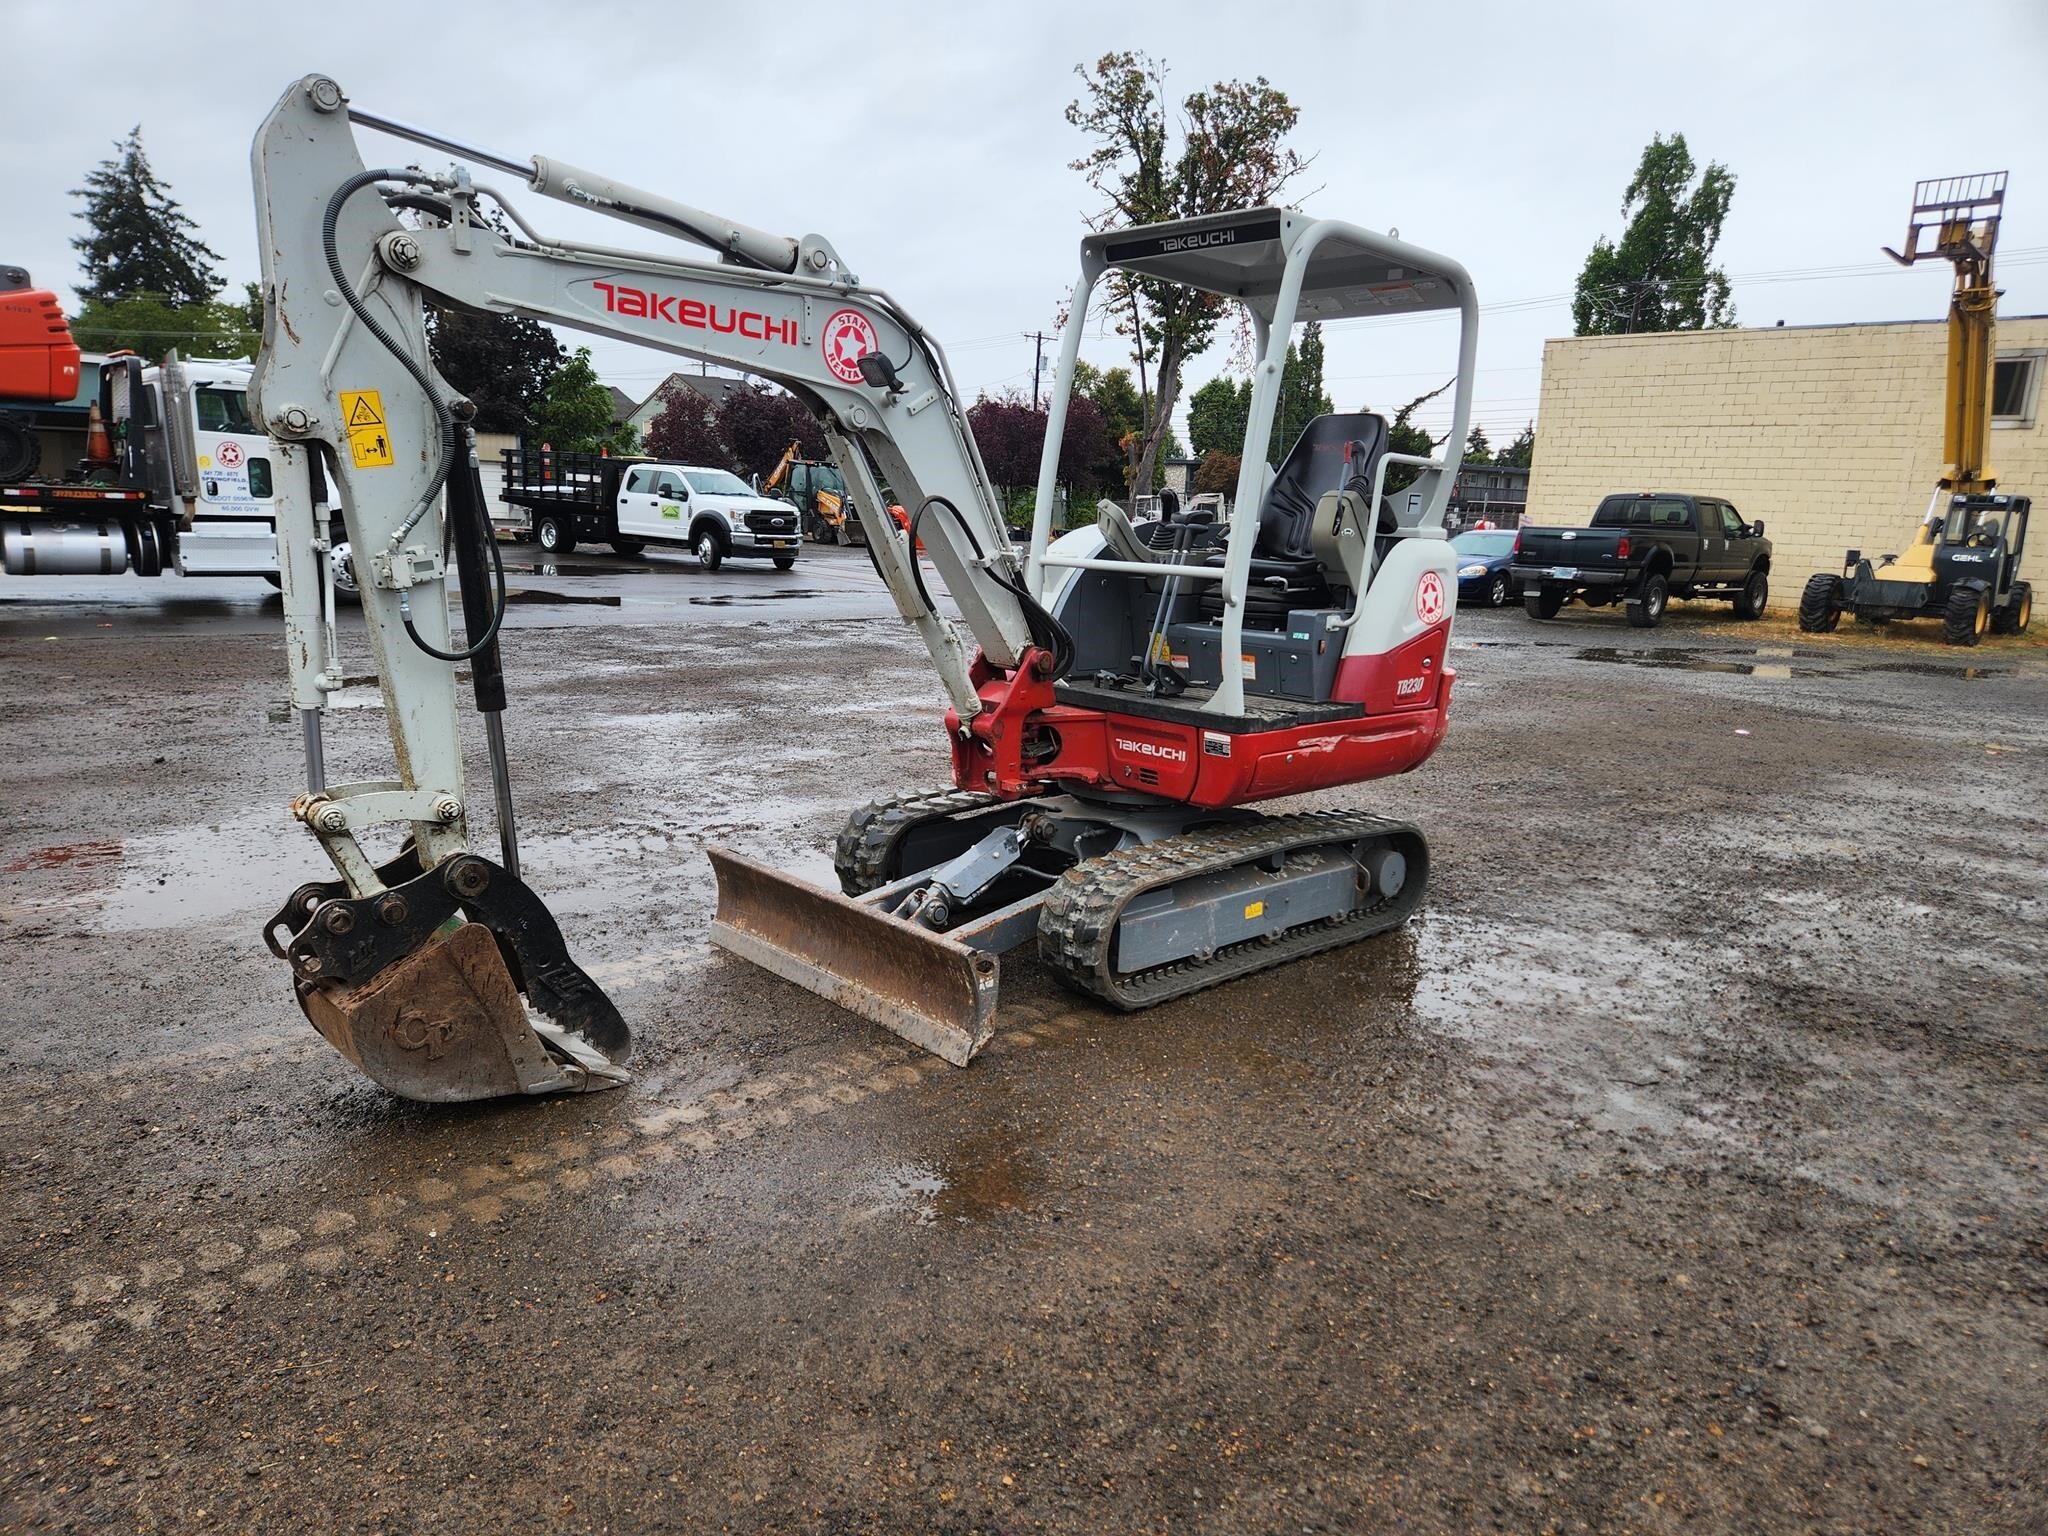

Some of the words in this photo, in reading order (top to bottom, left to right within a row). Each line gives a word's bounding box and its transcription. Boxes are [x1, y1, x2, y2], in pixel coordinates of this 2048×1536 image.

[838, 315, 867, 332] STAR
[828, 352, 861, 380] RENTA
[1406, 494, 1422, 513] F
[1952, 554, 1983, 563] GEHL
[1422, 575, 1437, 584] STAR
[1397, 676, 1425, 695] TB230
